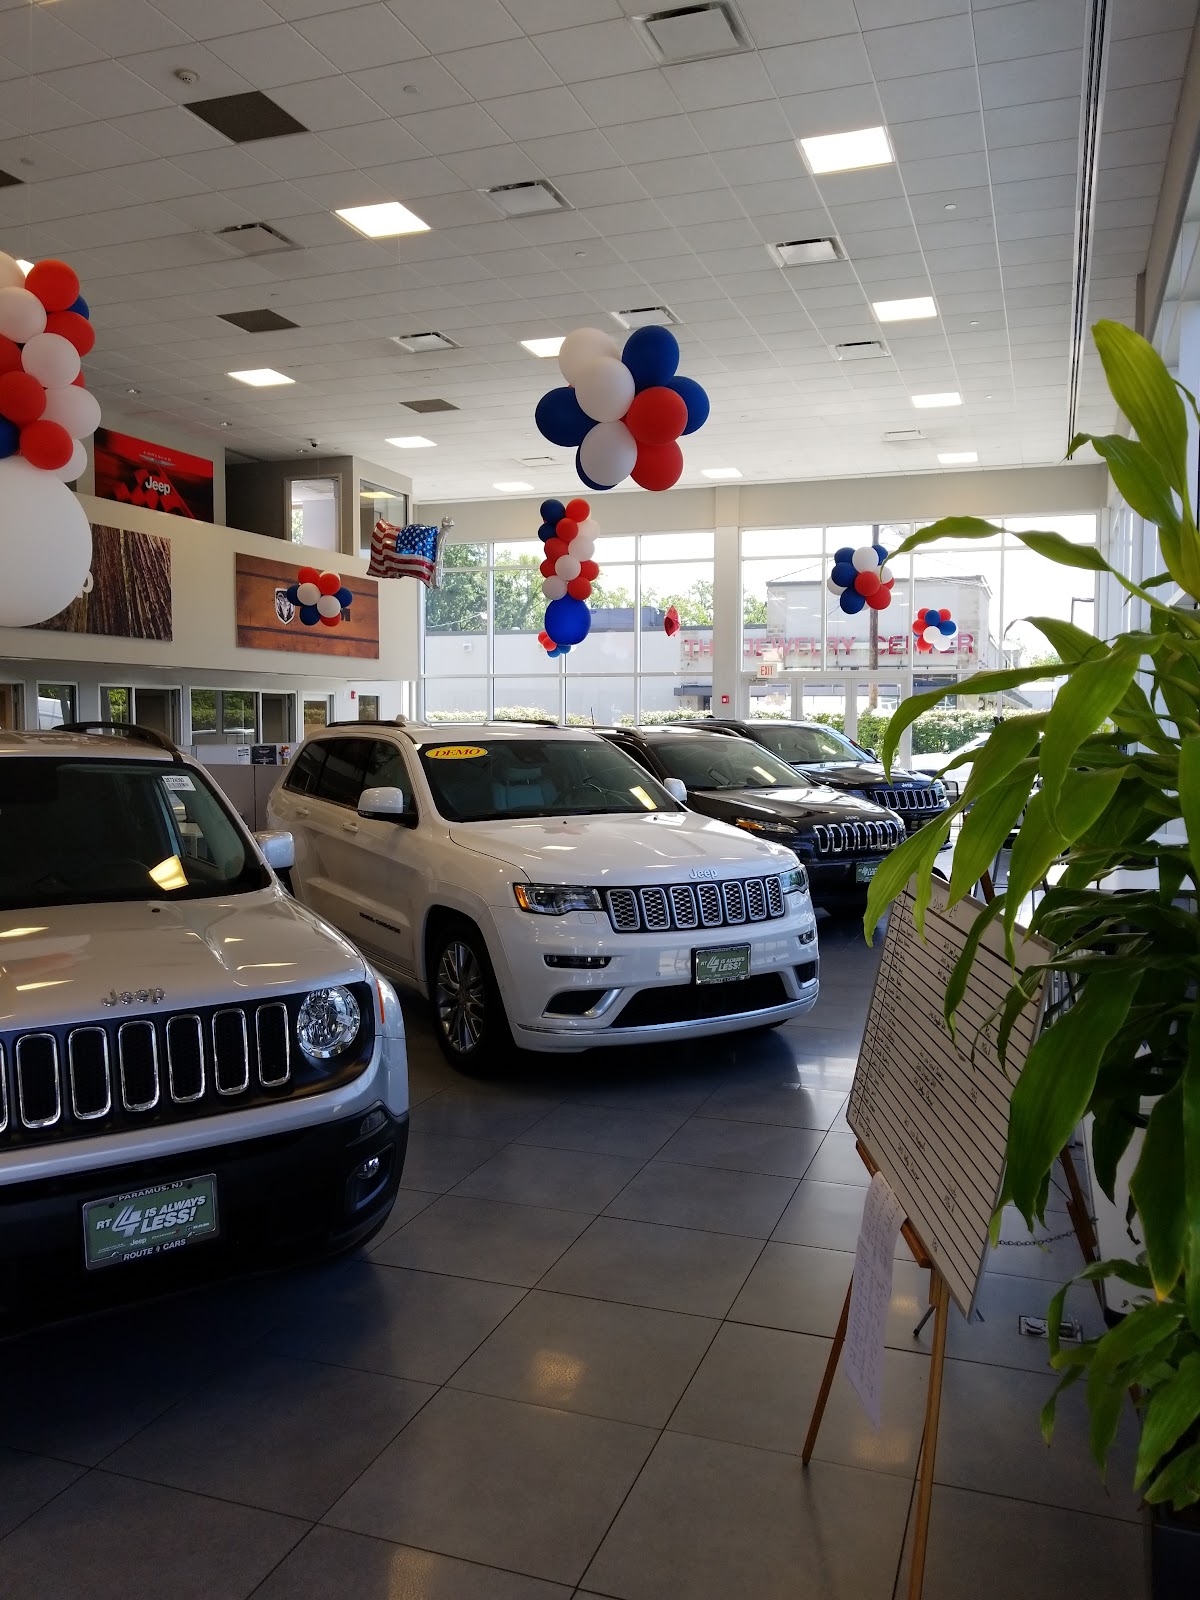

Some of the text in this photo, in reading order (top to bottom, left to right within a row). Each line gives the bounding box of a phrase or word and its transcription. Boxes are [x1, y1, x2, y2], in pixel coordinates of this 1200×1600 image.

[145, 475, 171, 496] Jeep
[684, 639, 714, 657] TH
[760, 665, 773, 676] EXIT
[434, 748, 480, 757] DEMO
[689, 868, 718, 880] Jeep
[707, 956, 720, 972] 4
[717, 962, 742, 972] LESS!
[101, 987, 166, 1007] Jeep
[171, 1182, 184, 1190] NJ
[96, 1195, 206, 1238] RT 4 IS ALWAYS
[140, 1207, 198, 1234] LESS!
[123, 1247, 153, 1261] ROUTE
[162, 1238, 187, 1251] CARS
[129, 1237, 147, 1247] Jeep
